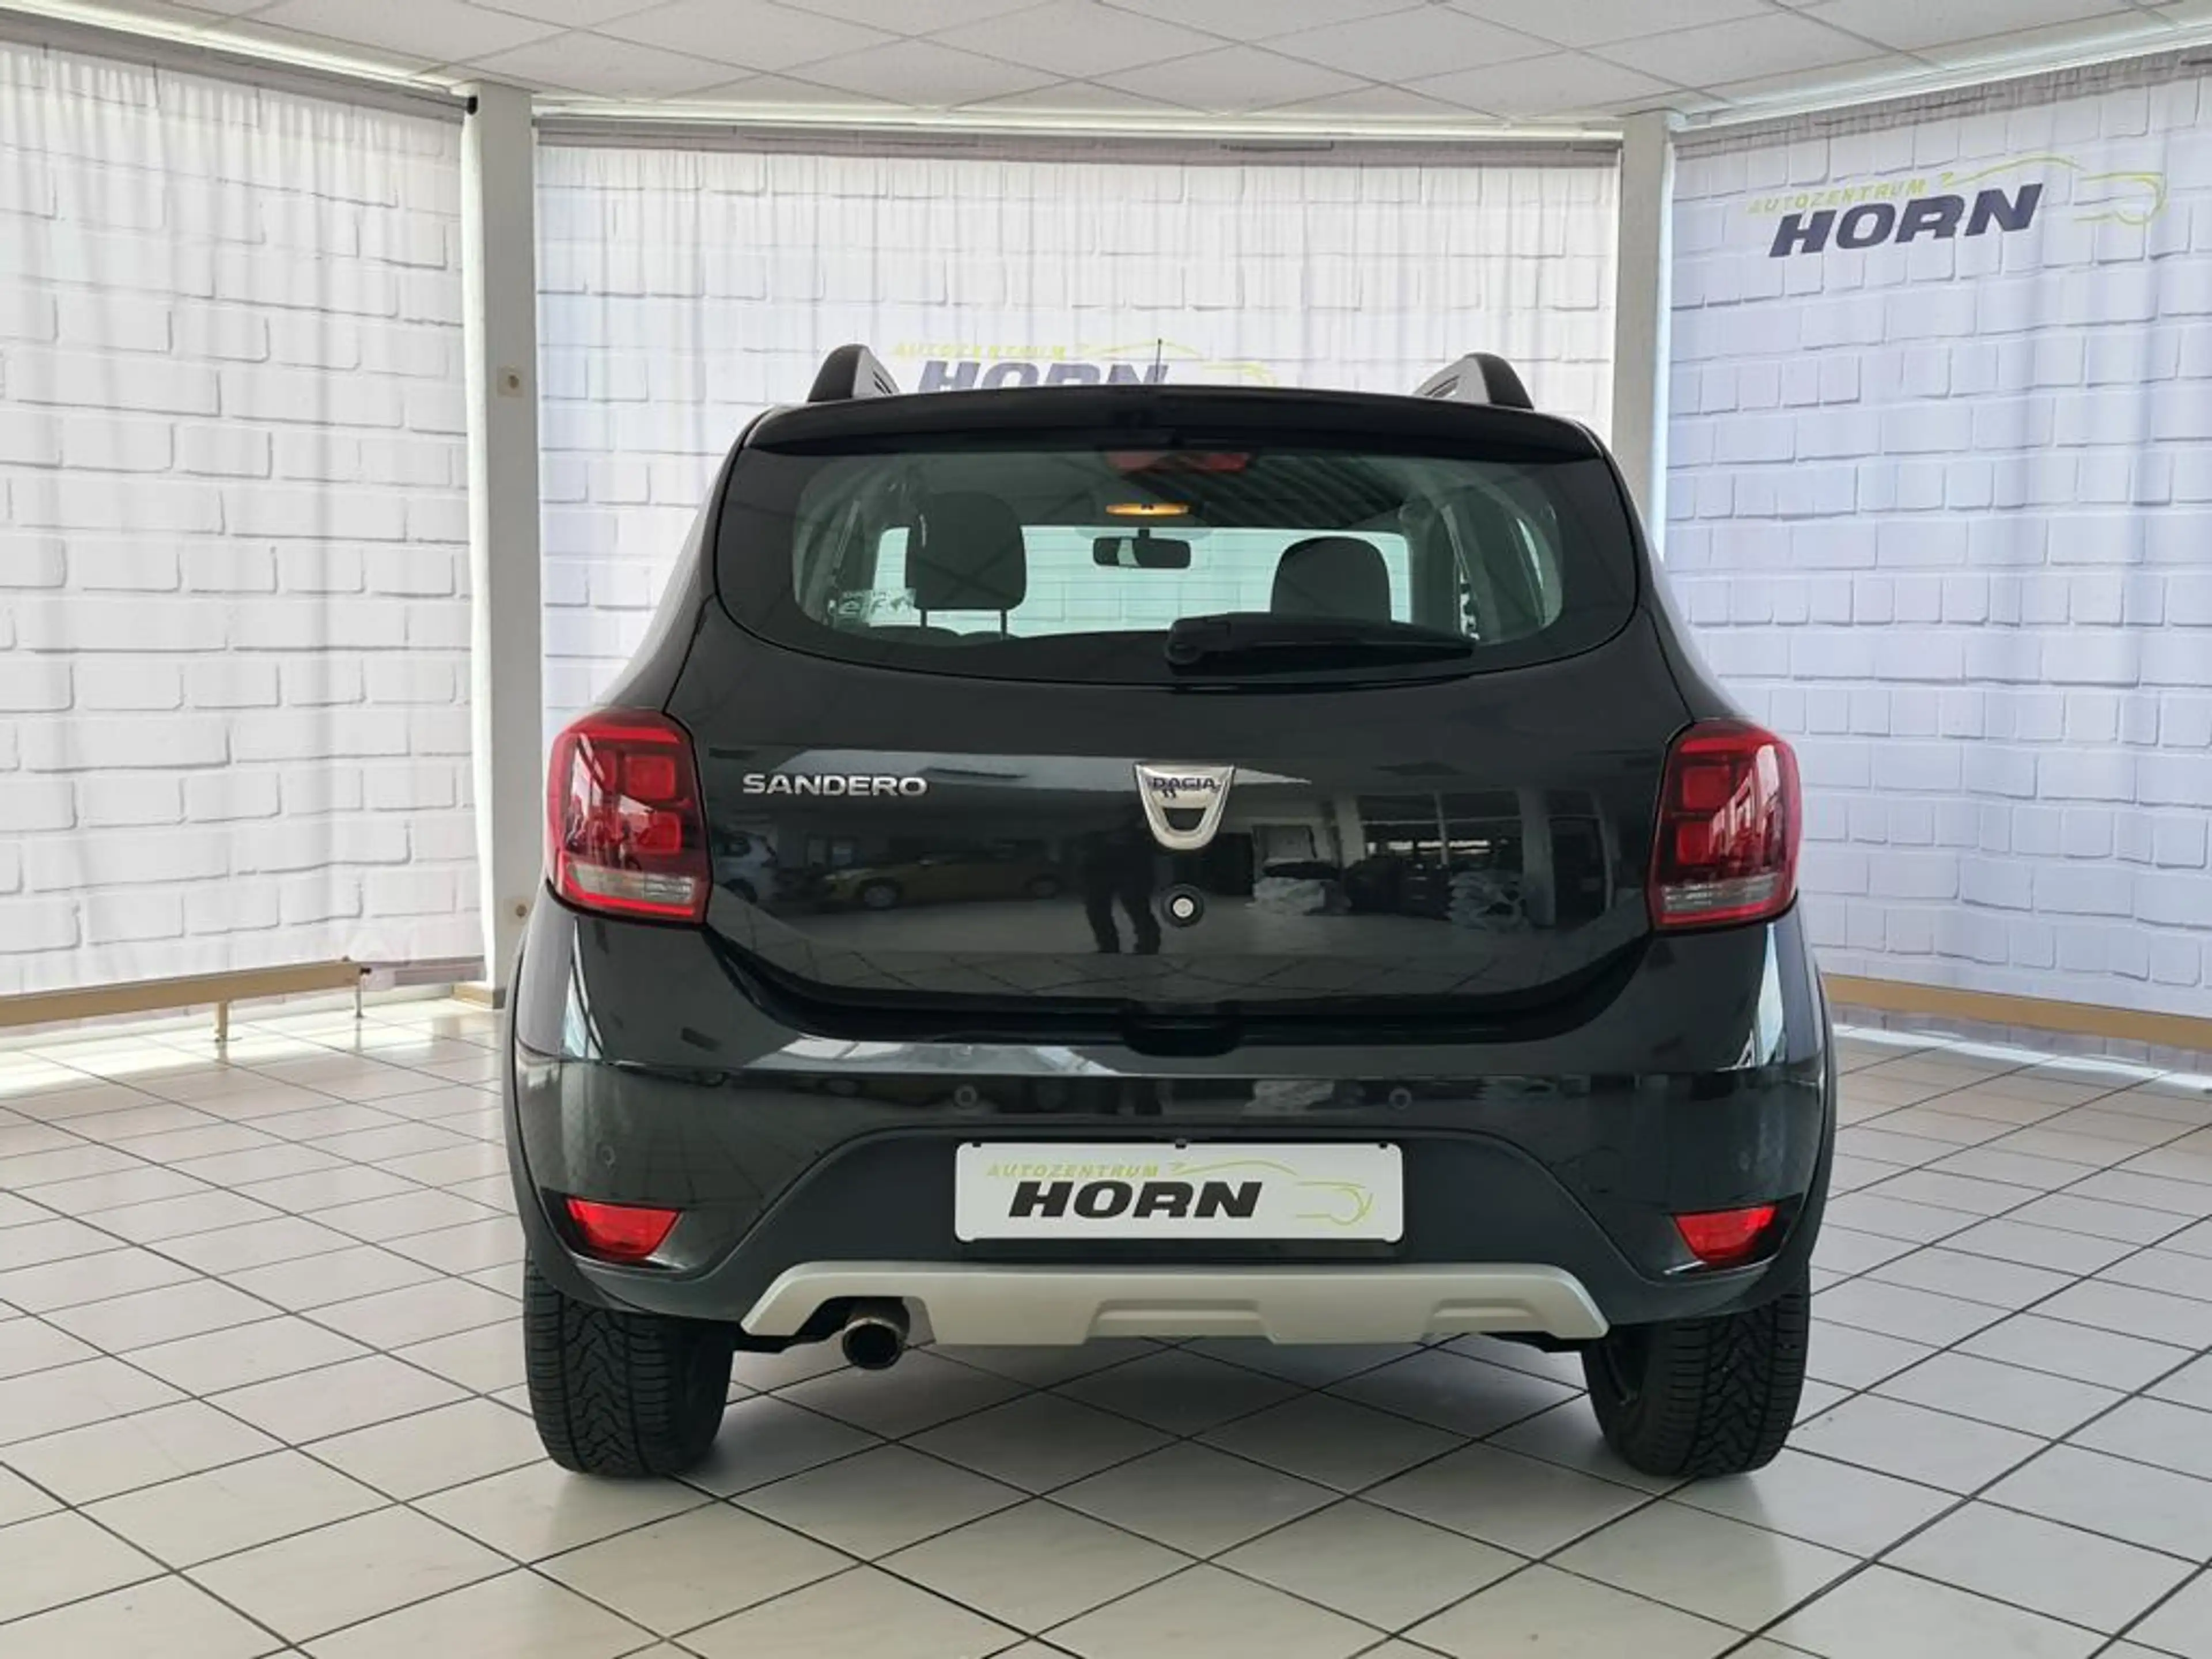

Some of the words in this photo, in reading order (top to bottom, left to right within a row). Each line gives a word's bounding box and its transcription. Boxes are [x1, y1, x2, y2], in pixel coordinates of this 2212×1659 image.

[1748, 178, 1926, 214] AUTOZENTRUM
[1769, 183, 2043, 257] HORN
[742, 772, 928, 797] SANDERO
[1153, 777, 1217, 790] DACIA
[987, 1164, 1158, 1177] AUTOZENTRUM
[1008, 1180, 1263, 1219] HORN
